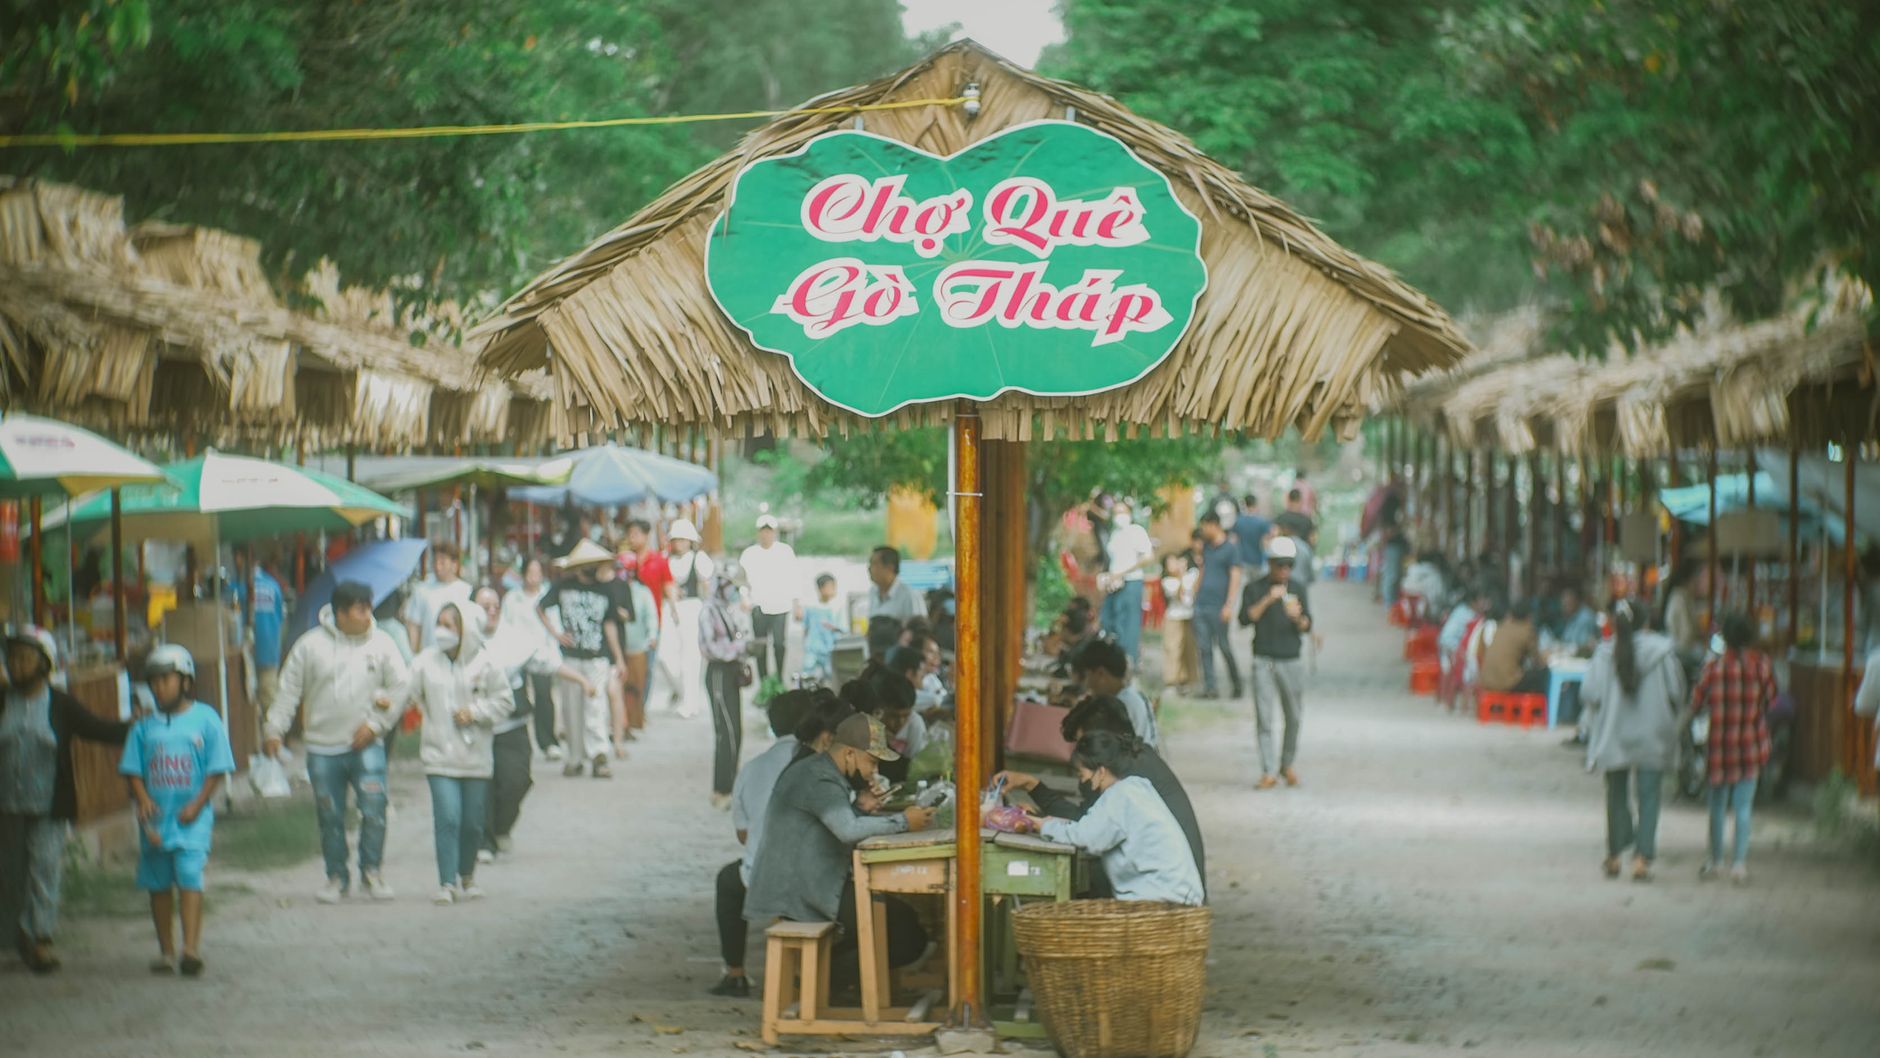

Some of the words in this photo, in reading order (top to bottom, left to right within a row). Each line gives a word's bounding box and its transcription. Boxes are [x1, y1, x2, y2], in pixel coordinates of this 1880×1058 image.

[807, 181, 966, 251] Chợ
[989, 184, 1135, 251] Quê
[782, 265, 902, 331] Gò
[939, 267, 1155, 336] Tháp
